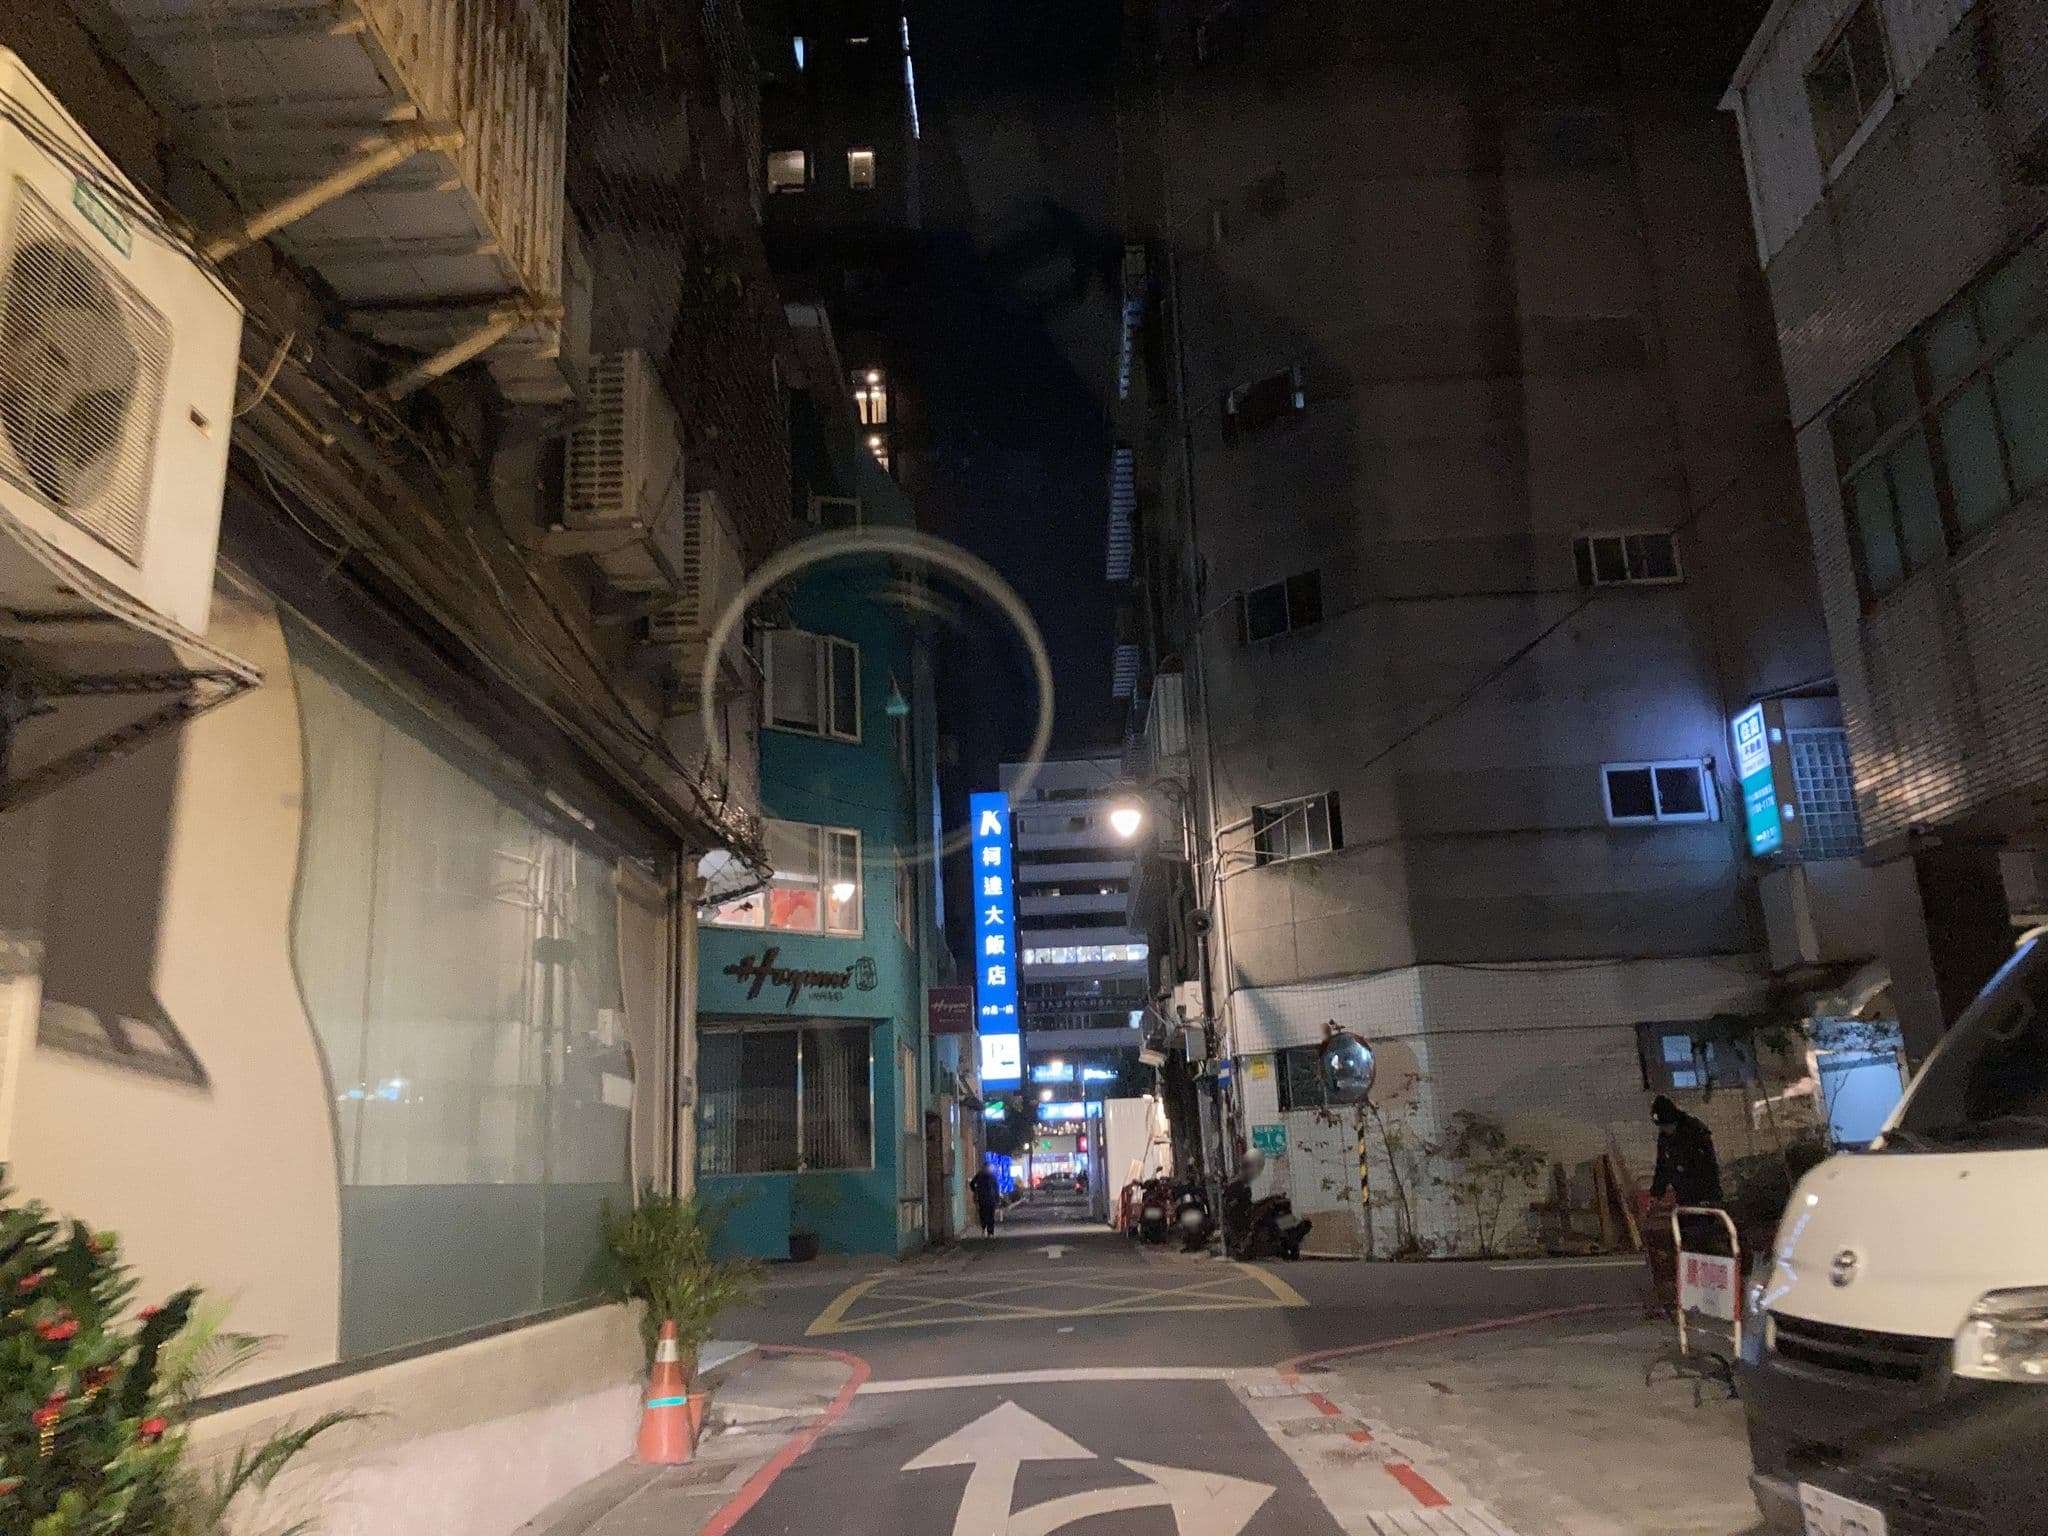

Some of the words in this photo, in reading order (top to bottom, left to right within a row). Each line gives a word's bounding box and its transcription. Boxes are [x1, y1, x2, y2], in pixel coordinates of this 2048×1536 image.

[982, 846, 1006, 986] 柯達大飯店
